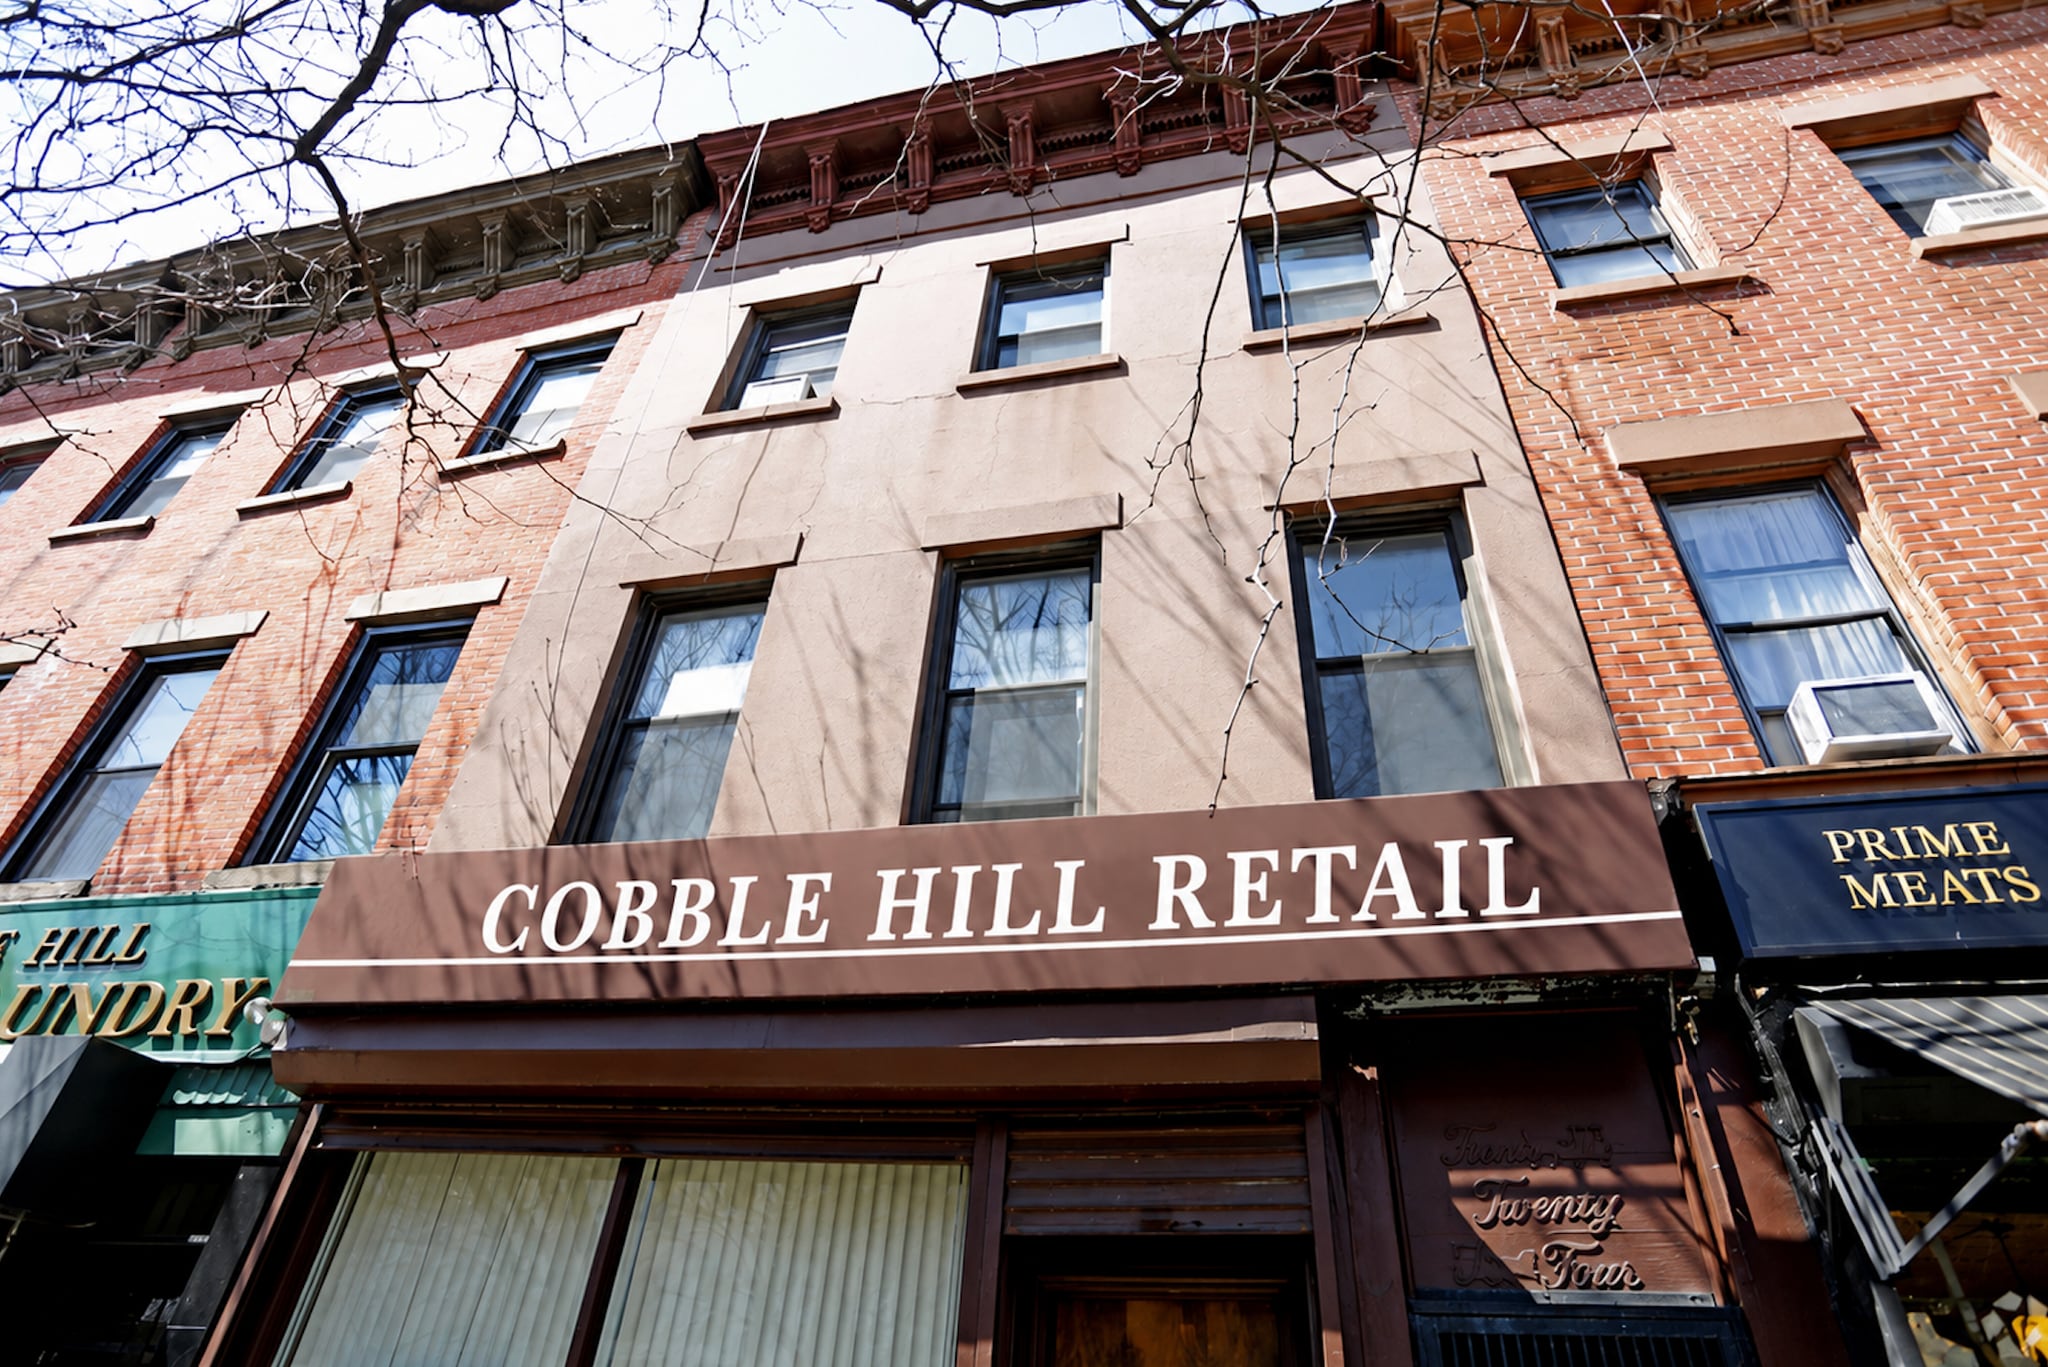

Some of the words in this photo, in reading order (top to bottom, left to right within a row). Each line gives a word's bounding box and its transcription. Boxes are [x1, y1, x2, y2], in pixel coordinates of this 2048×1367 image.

[1822, 821, 2010, 863] PRIME
[482, 872, 833, 954] COBBLE
[867, 860, 1106, 942] HILL
[1148, 837, 1541, 931] RETAIL
[1840, 866, 2041, 909] MEATS
[22, 923, 150, 964] HILL
[1472, 1175, 1622, 1235] Twenty
[1541, 1240, 1643, 1289] Four
